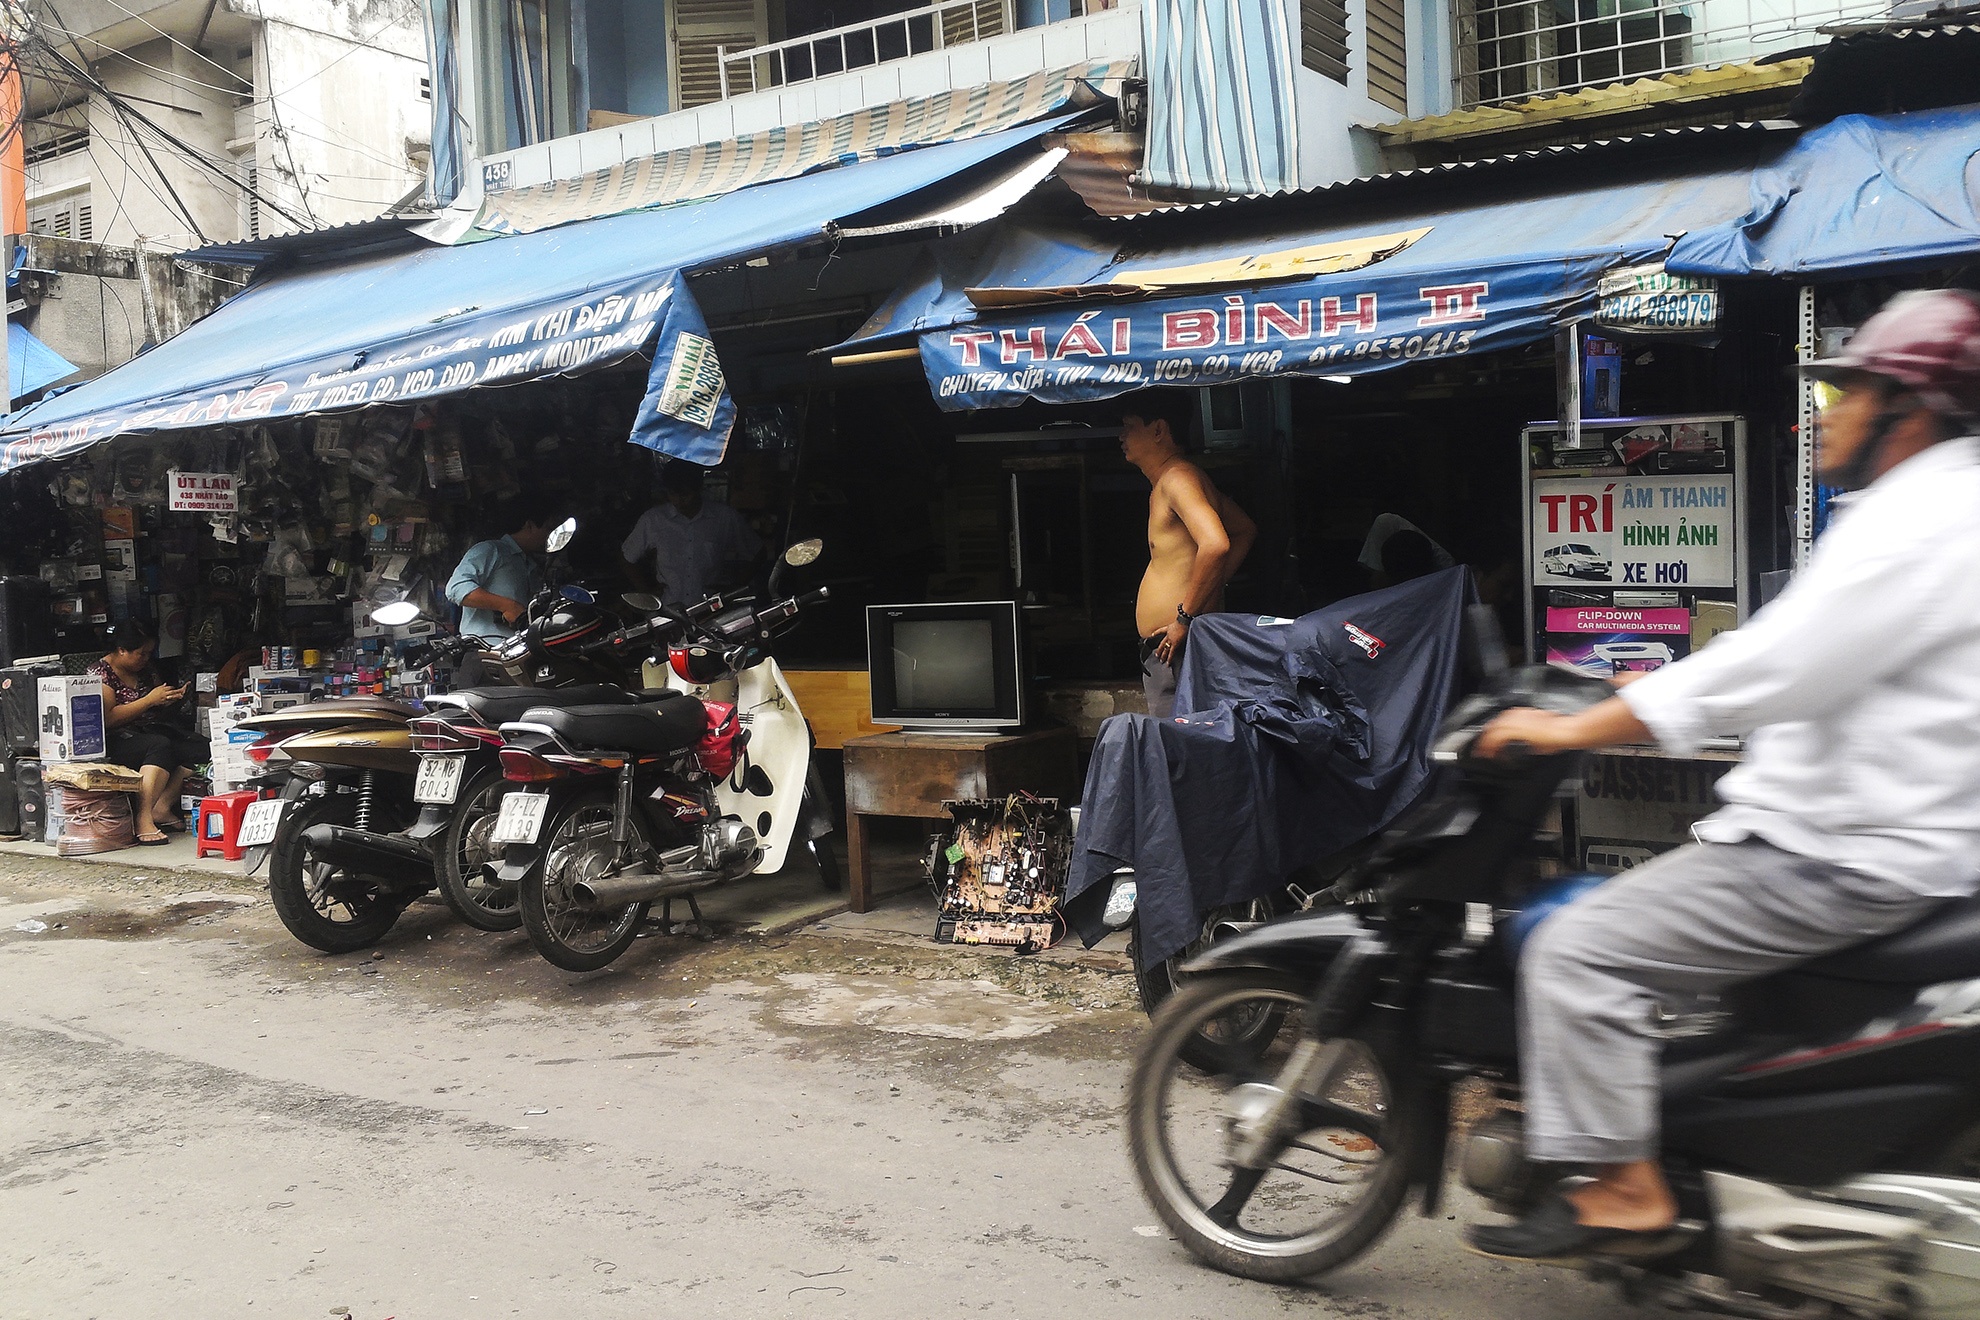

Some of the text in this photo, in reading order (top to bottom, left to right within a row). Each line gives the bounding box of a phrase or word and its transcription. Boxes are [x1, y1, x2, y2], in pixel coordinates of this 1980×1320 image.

[486, 162, 508, 181] 438
[488, 319, 535, 349] KIM
[532, 302, 584, 341] KHÍ
[573, 295, 633, 333] ĐIỆN
[950, 282, 1488, 366] THÁI BÌNH II
[675, 362, 696, 389] NAM
[939, 370, 1006, 397] CHUYÊN
[1201, 355, 1234, 379] CD,
[177, 474, 231, 489] ÚT LAN
[1540, 483, 1727, 532] TRÍ ÂM THANH
[1623, 517, 1718, 546] HÌNH ẢNH
[1623, 560, 1688, 583] XE HƠI
[1577, 611, 1642, 621] FLIP-DOWN
[525, 709, 554, 717] HONDA
[1583, 757, 1728, 804] CASSETT
